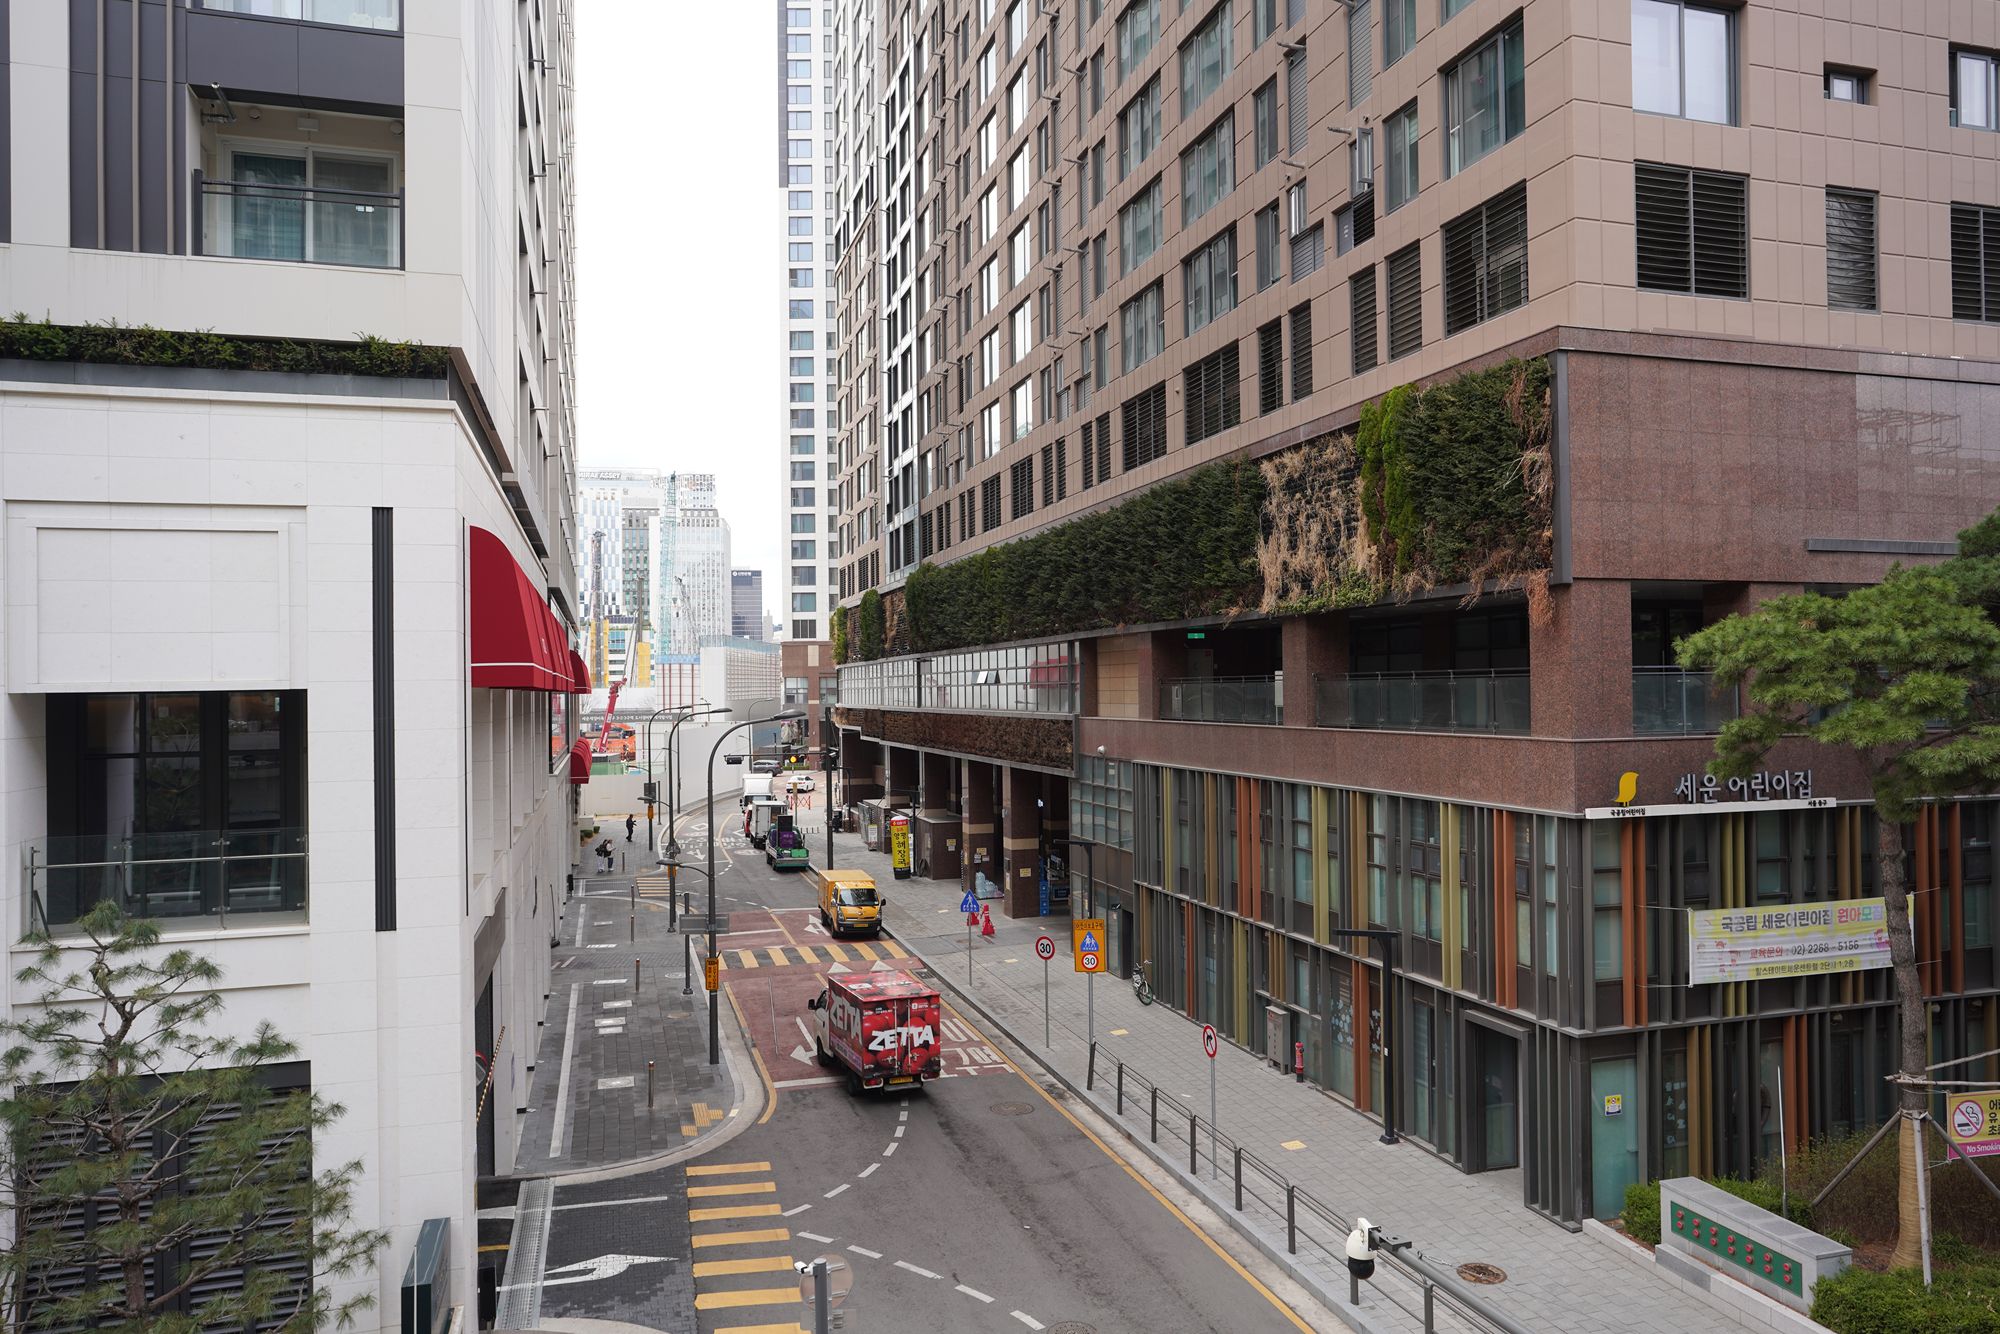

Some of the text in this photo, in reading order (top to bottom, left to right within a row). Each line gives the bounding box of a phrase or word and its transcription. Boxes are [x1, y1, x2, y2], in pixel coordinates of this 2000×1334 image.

[1676, 769, 1812, 803] 세운 어린이집
[1610, 808, 1646, 816] 국공립어린이집
[1721, 905, 1883, 932] 국공립 세운어린이집 원아모집
[1040, 943, 1051, 954] 30
[1084, 957, 1096, 965] 30
[830, 989, 863, 1045] ZETTA
[869, 1025, 935, 1051] ZETTA
[1989, 1099, 2000, 1111] 어
[1988, 1124, 2000, 1136] 초
[1967, 1145, 1976, 1153] No
